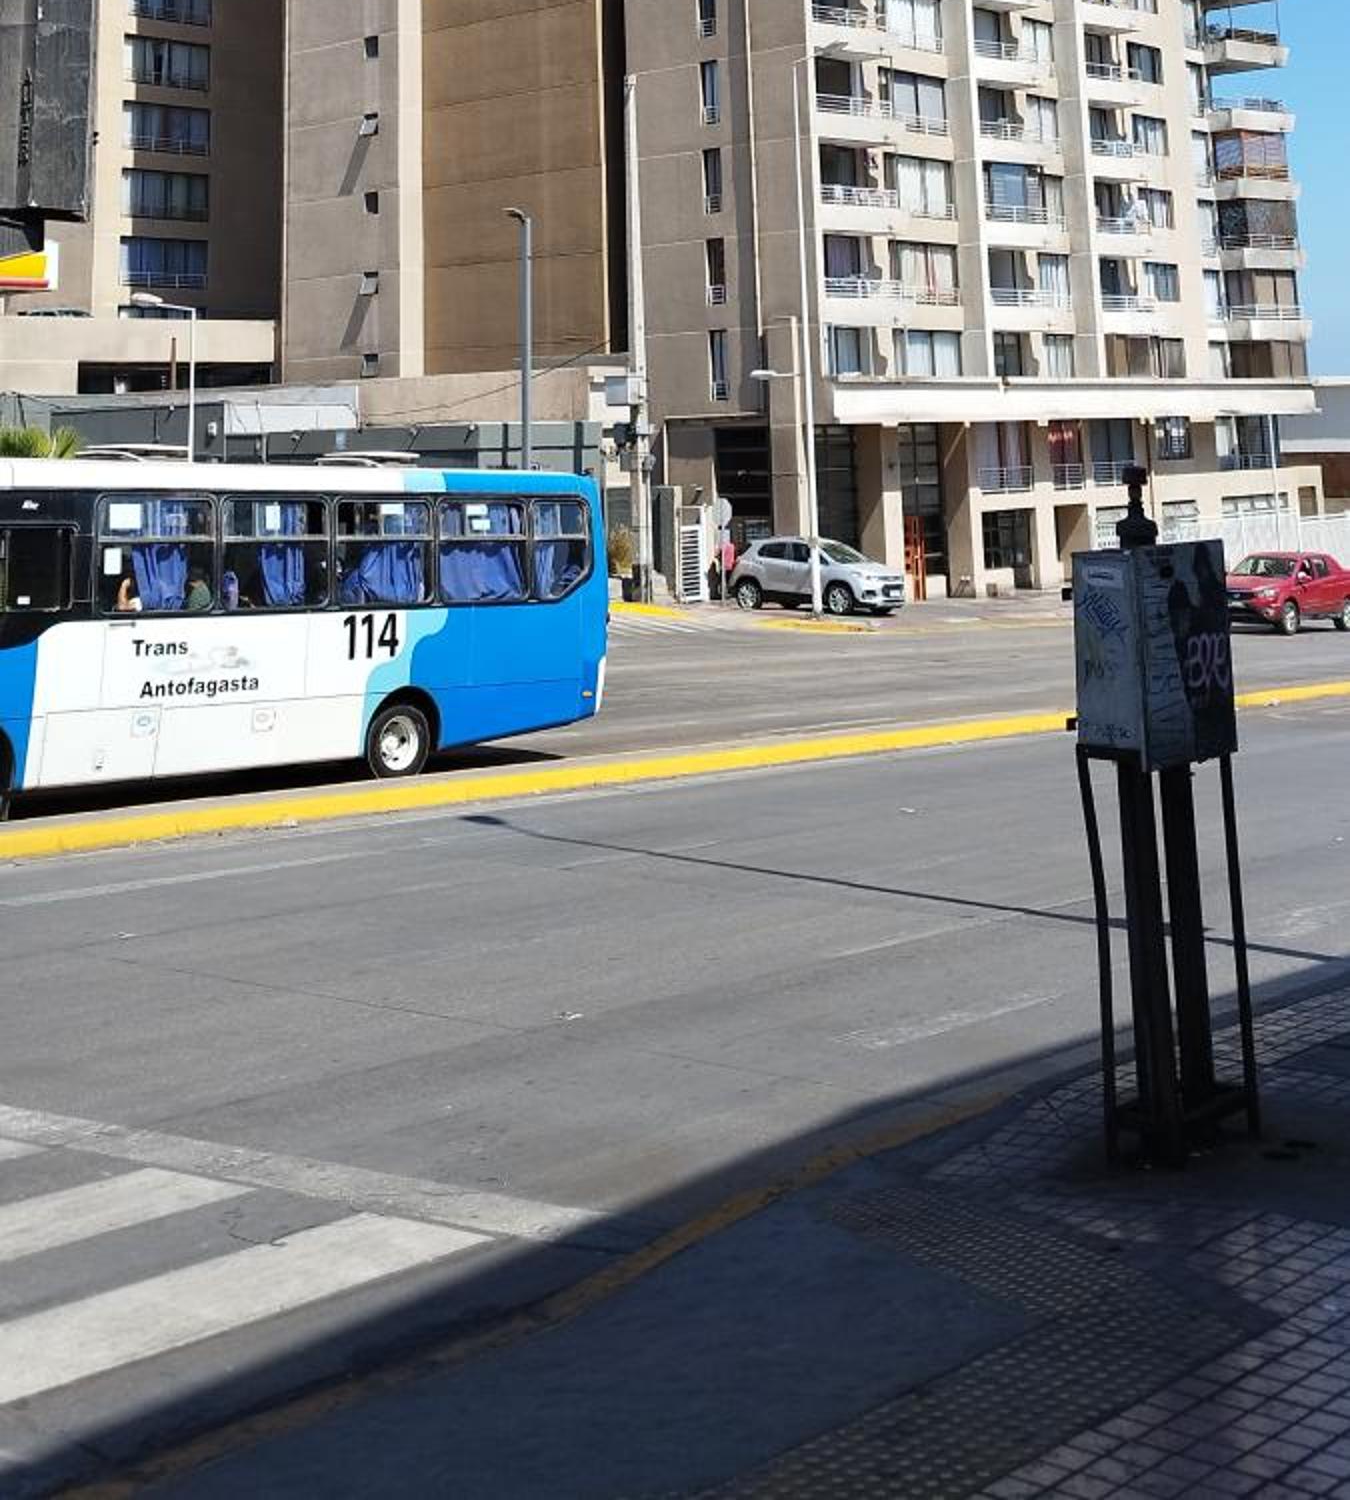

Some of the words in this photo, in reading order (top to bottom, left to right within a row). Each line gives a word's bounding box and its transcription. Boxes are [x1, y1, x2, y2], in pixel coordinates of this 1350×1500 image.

[132, 639, 189, 657] Trans
[343, 613, 399, 660] 114
[139, 675, 260, 698] Antofagasta
